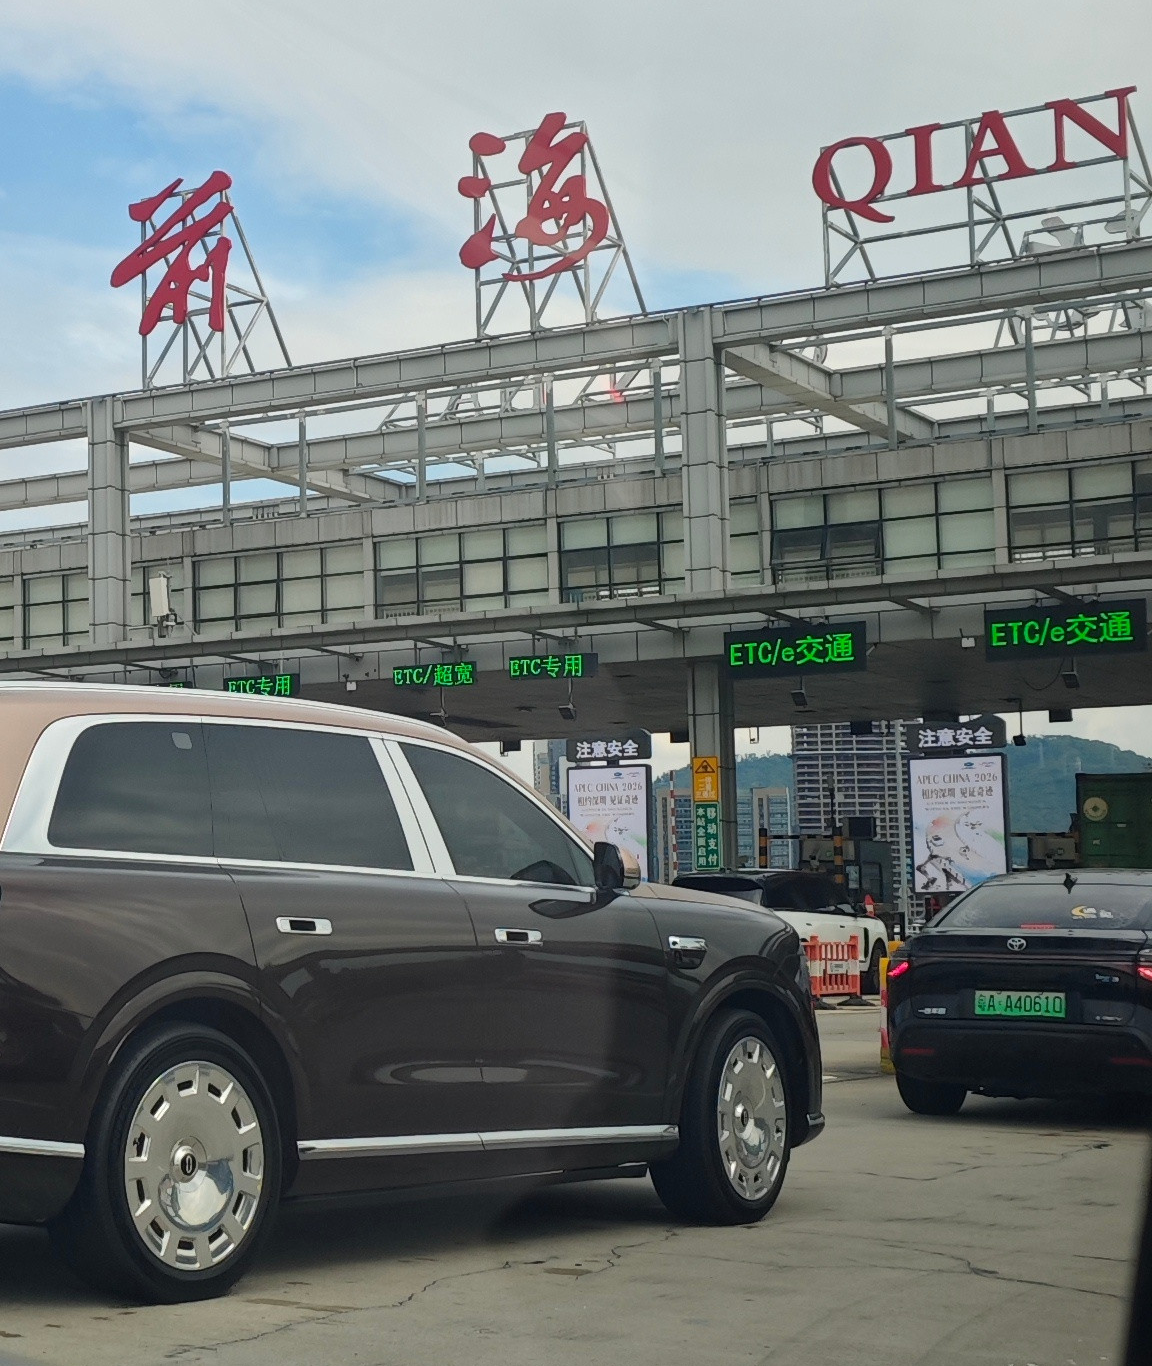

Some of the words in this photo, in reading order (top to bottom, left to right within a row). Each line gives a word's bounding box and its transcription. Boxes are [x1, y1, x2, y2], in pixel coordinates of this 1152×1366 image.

[813, 87, 1138, 223] QIAN
[991, 611, 1133, 647] ETC/e交通
[730, 633, 855, 666] ETC/e交通
[393, 662, 473, 686] ETC/超宽
[510, 654, 583, 678] ETC专用
[919, 726, 992, 747] 注意安全
[576, 740, 638, 758] 注意安全
[622, 781, 643, 791] 2026
[974, 772, 998, 782] 2026
